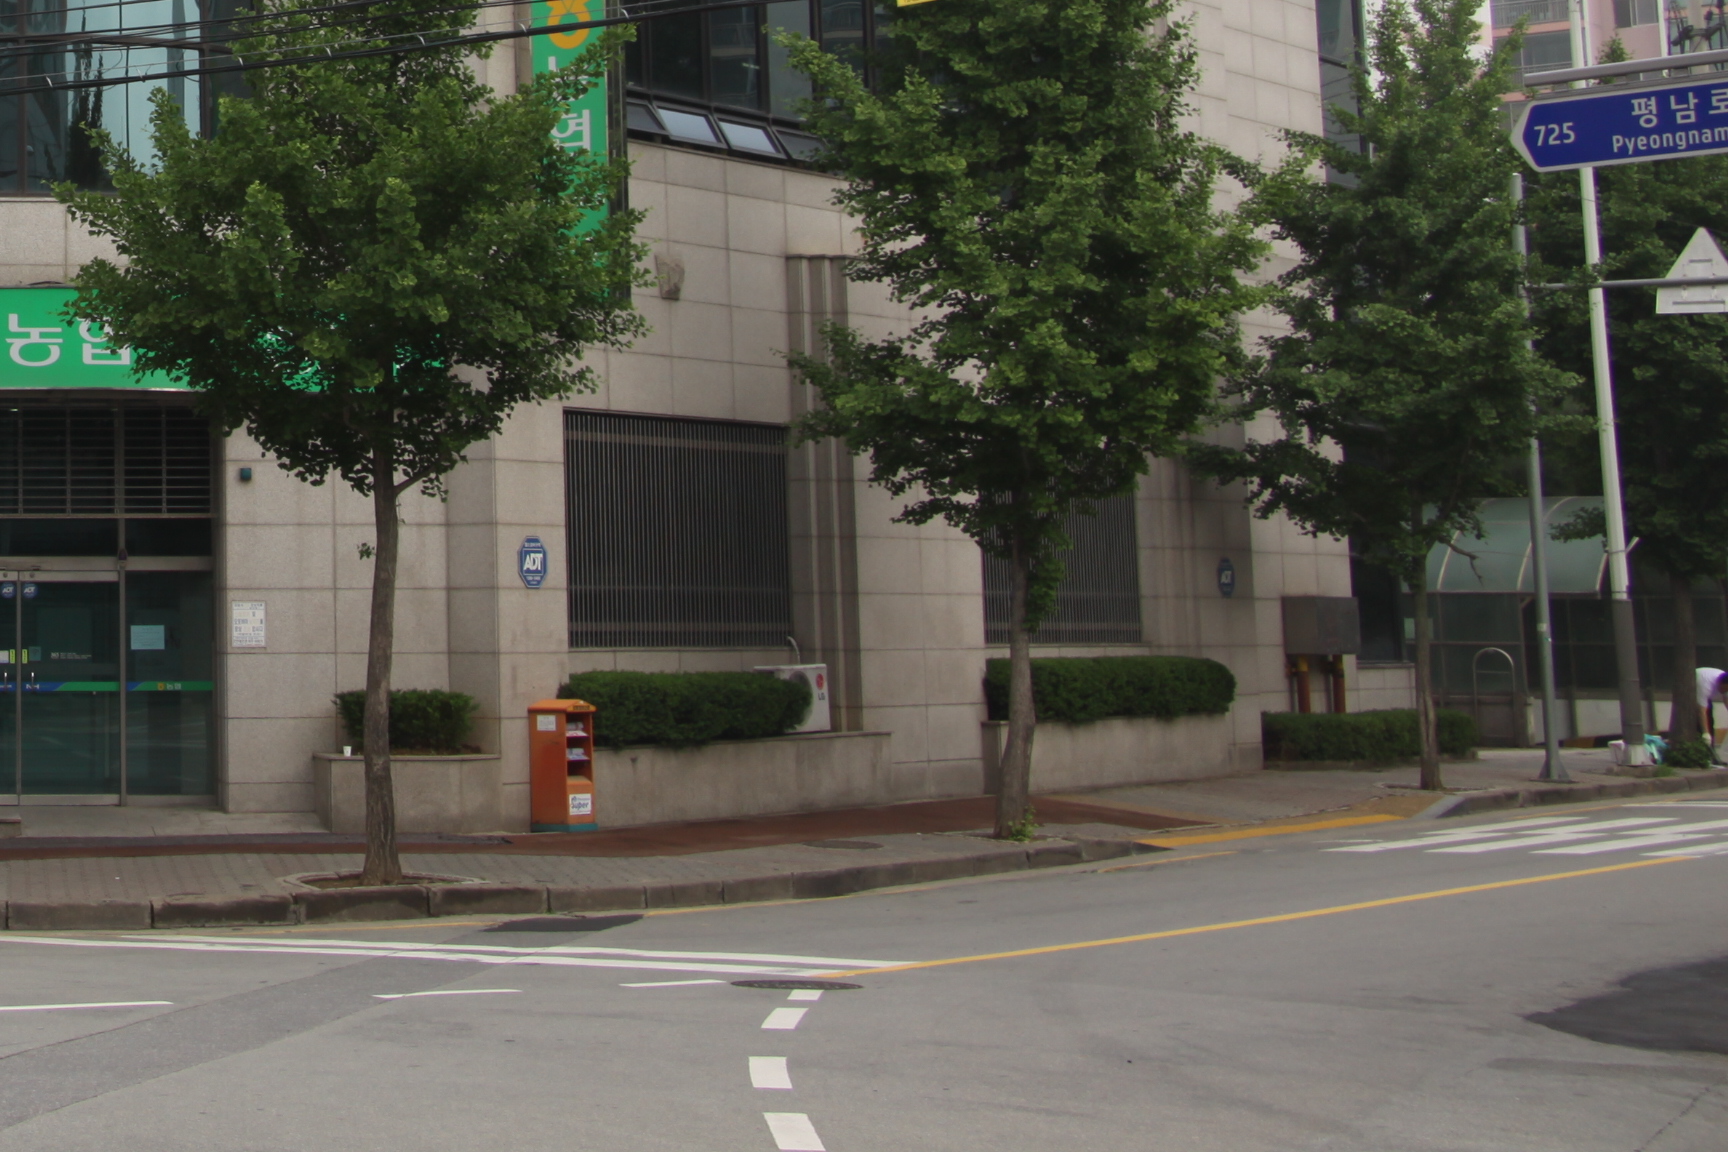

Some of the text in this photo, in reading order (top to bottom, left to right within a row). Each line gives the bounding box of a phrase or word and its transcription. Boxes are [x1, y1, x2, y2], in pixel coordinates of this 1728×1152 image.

[1630, 87, 1728, 129] 평남로
[1533, 121, 1577, 147] 725
[1612, 126, 1728, 155] Pyeongnam
[5, 313, 132, 367] 농협
[523, 552, 543, 571] ADT
[818, 692, 826, 701] LG
